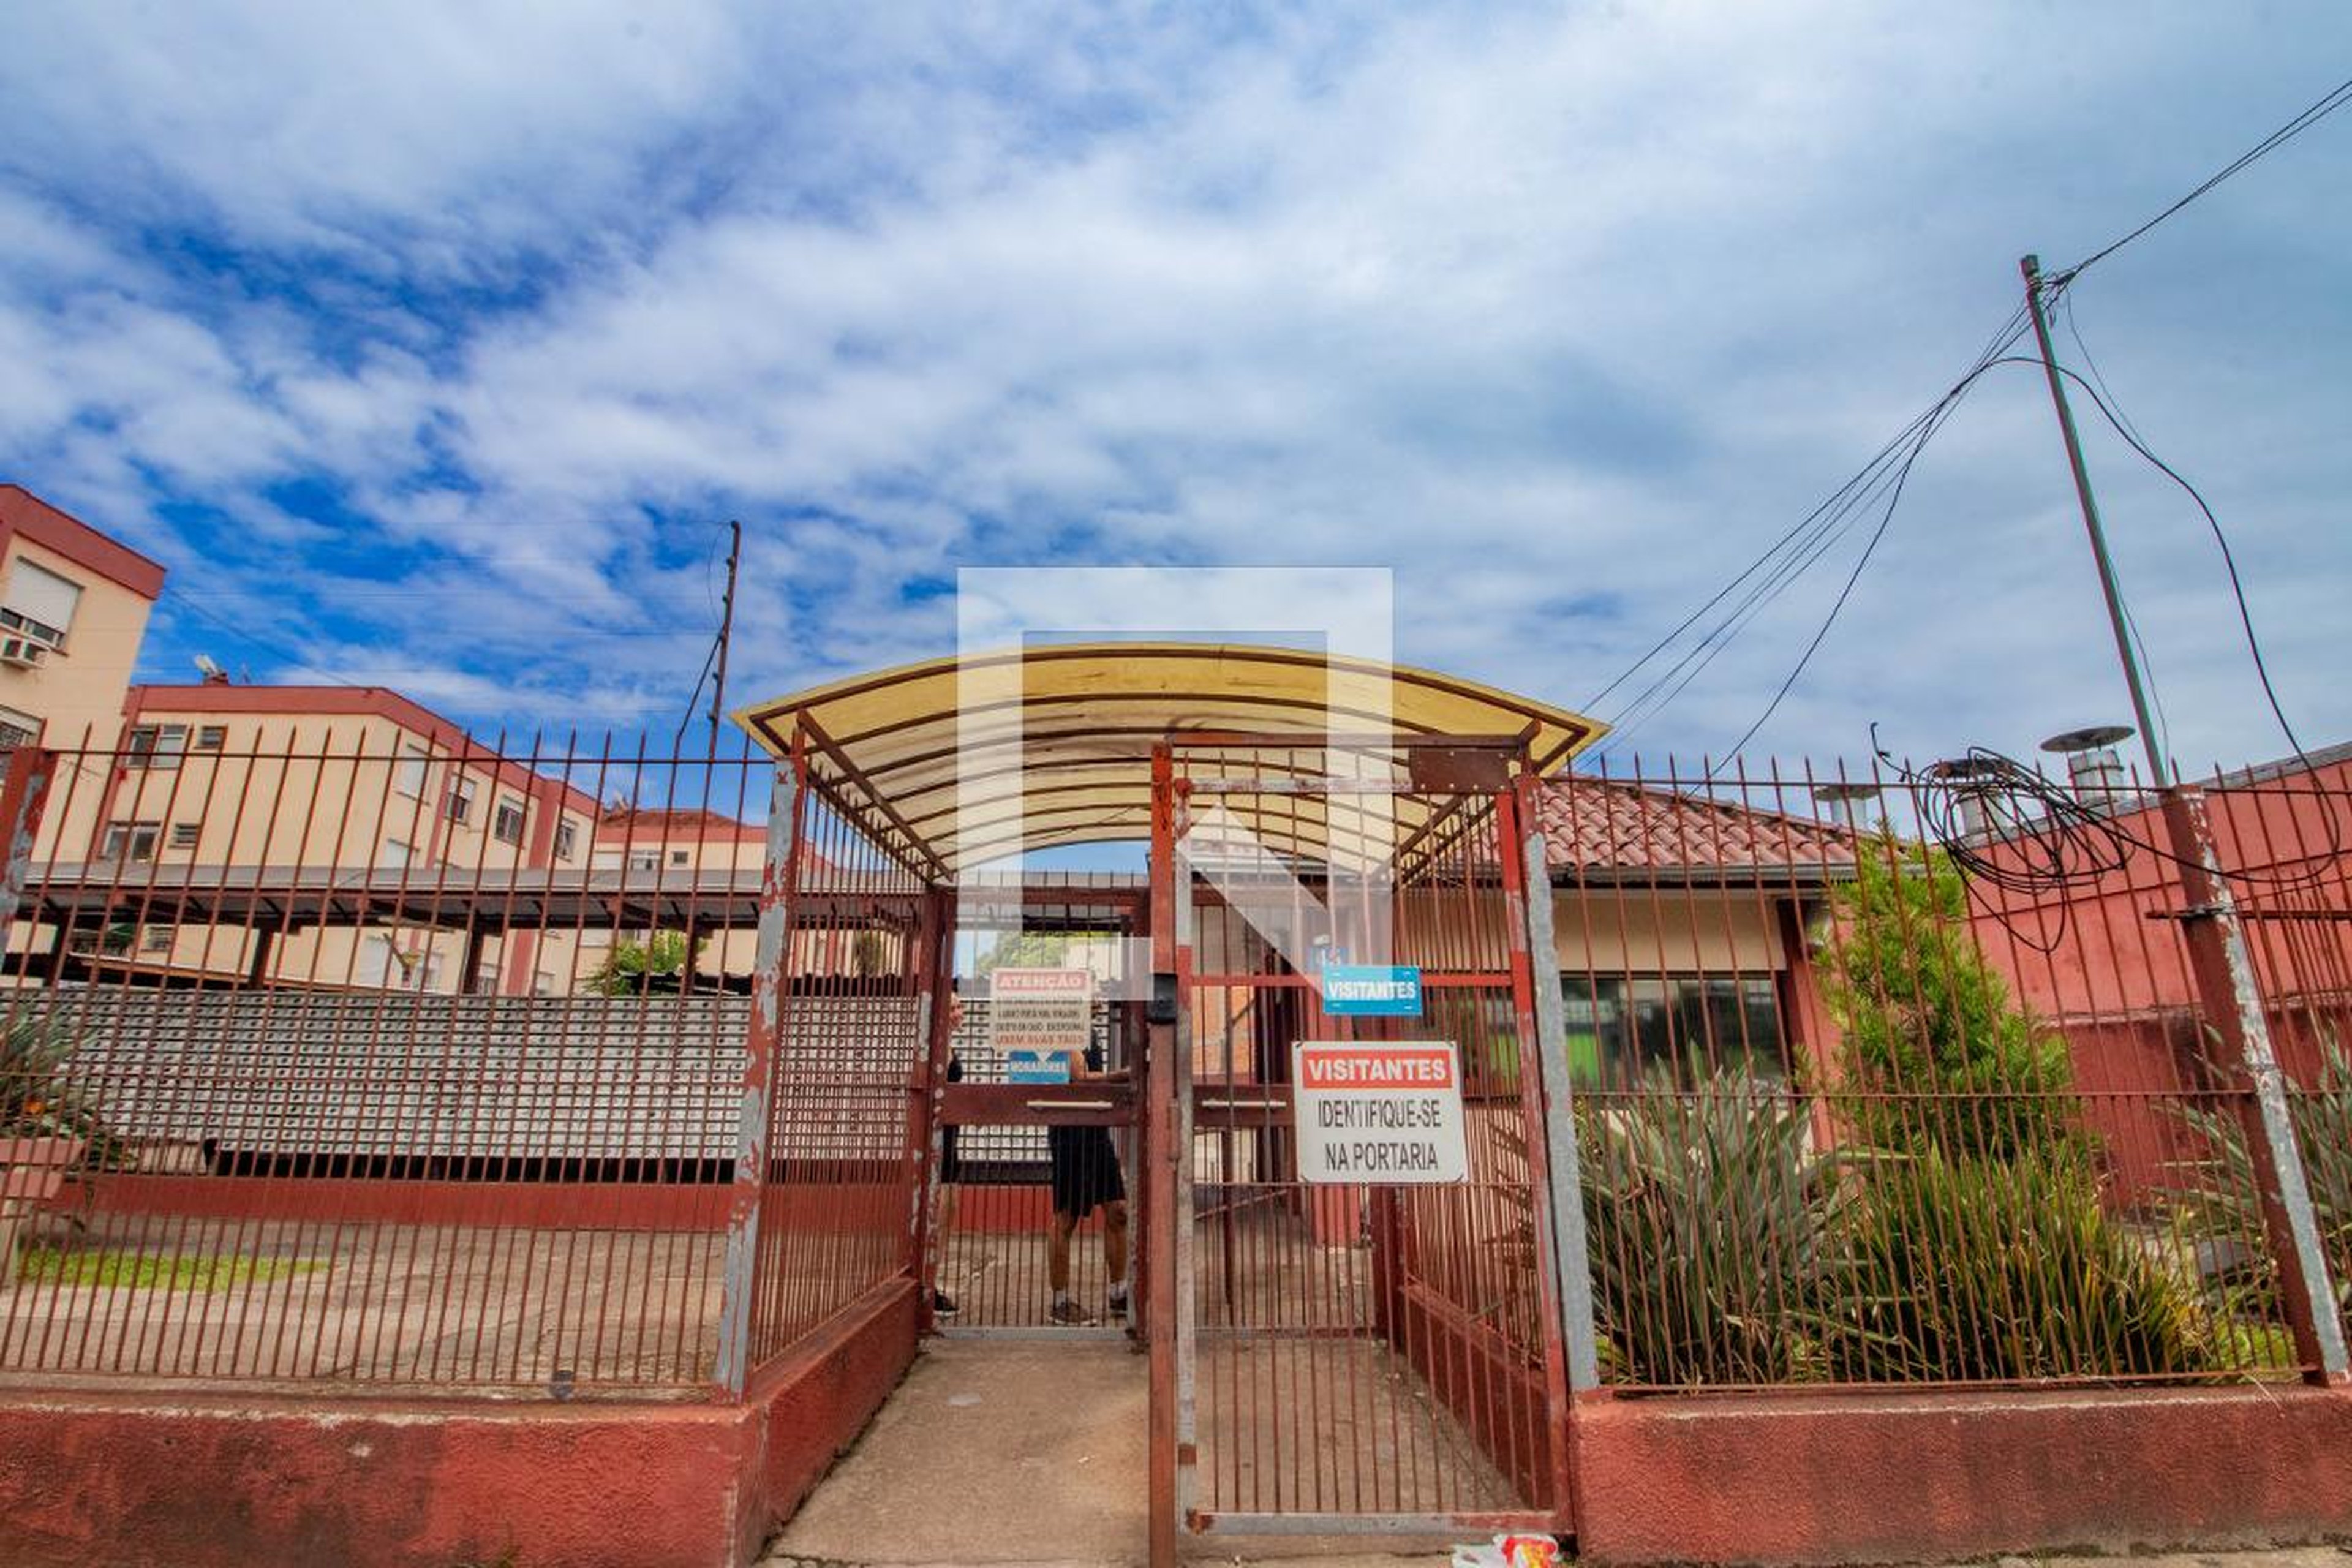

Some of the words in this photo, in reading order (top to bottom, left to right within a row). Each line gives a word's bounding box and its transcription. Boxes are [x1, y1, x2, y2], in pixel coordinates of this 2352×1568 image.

[1328, 981, 1416, 1000] VISITANTES
[1307, 1058, 1447, 1082] VISITANTES
[1318, 1099, 1442, 1128] IDENTIFIQUE-SE
[1325, 1142, 1348, 1171] NA
[1353, 1142, 1439, 1171] PORTARIA
